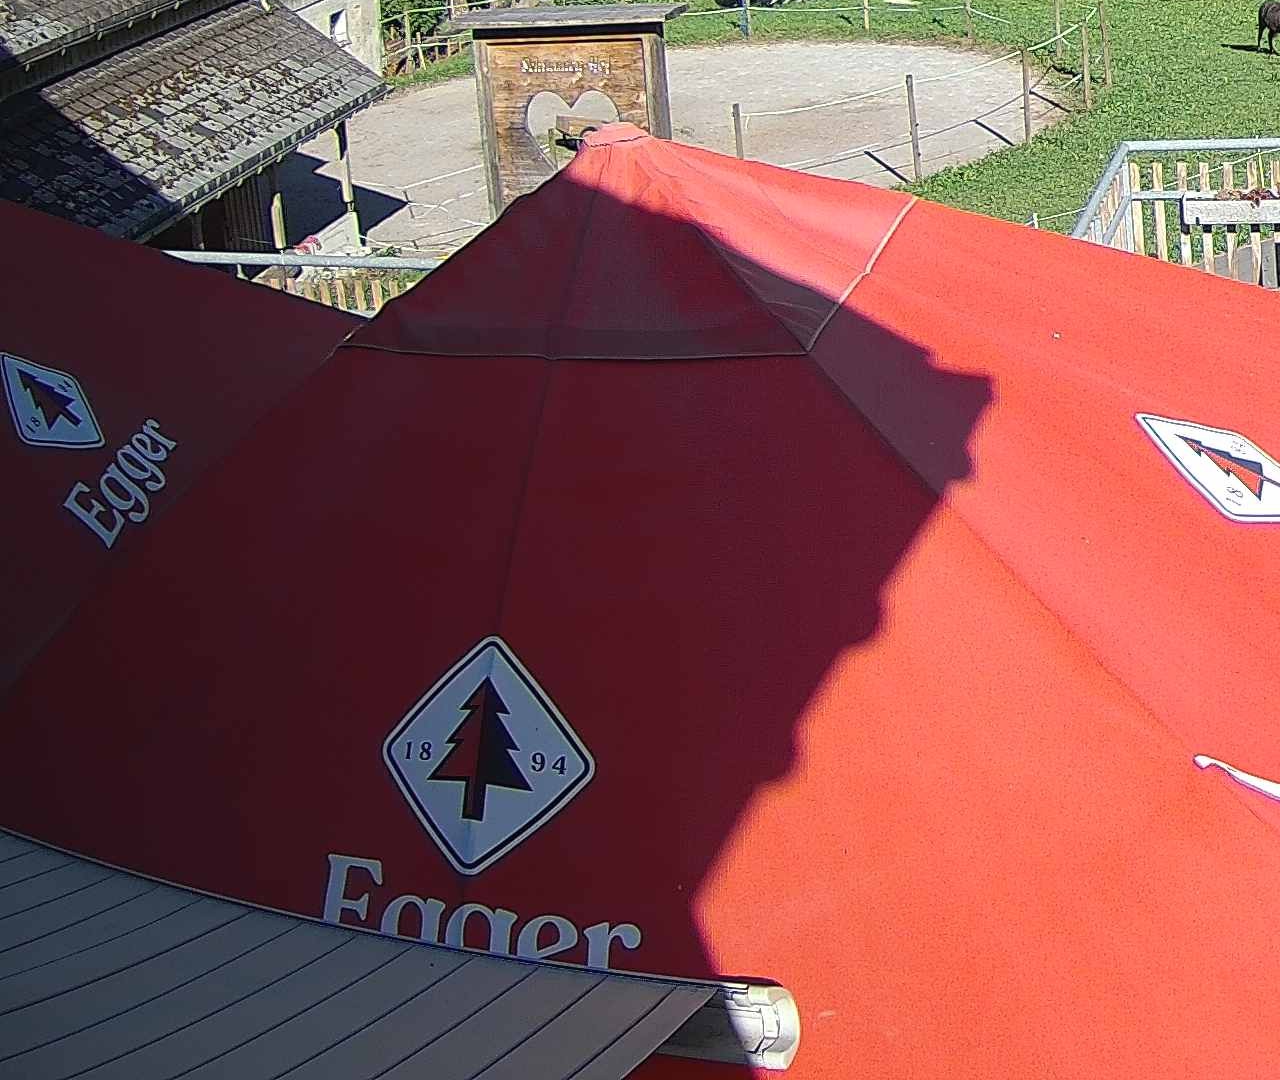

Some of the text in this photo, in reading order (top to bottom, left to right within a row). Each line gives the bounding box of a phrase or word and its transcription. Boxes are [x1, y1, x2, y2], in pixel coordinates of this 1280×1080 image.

[63, 418, 177, 549] Egger
[403, 740, 568, 776] 18 94
